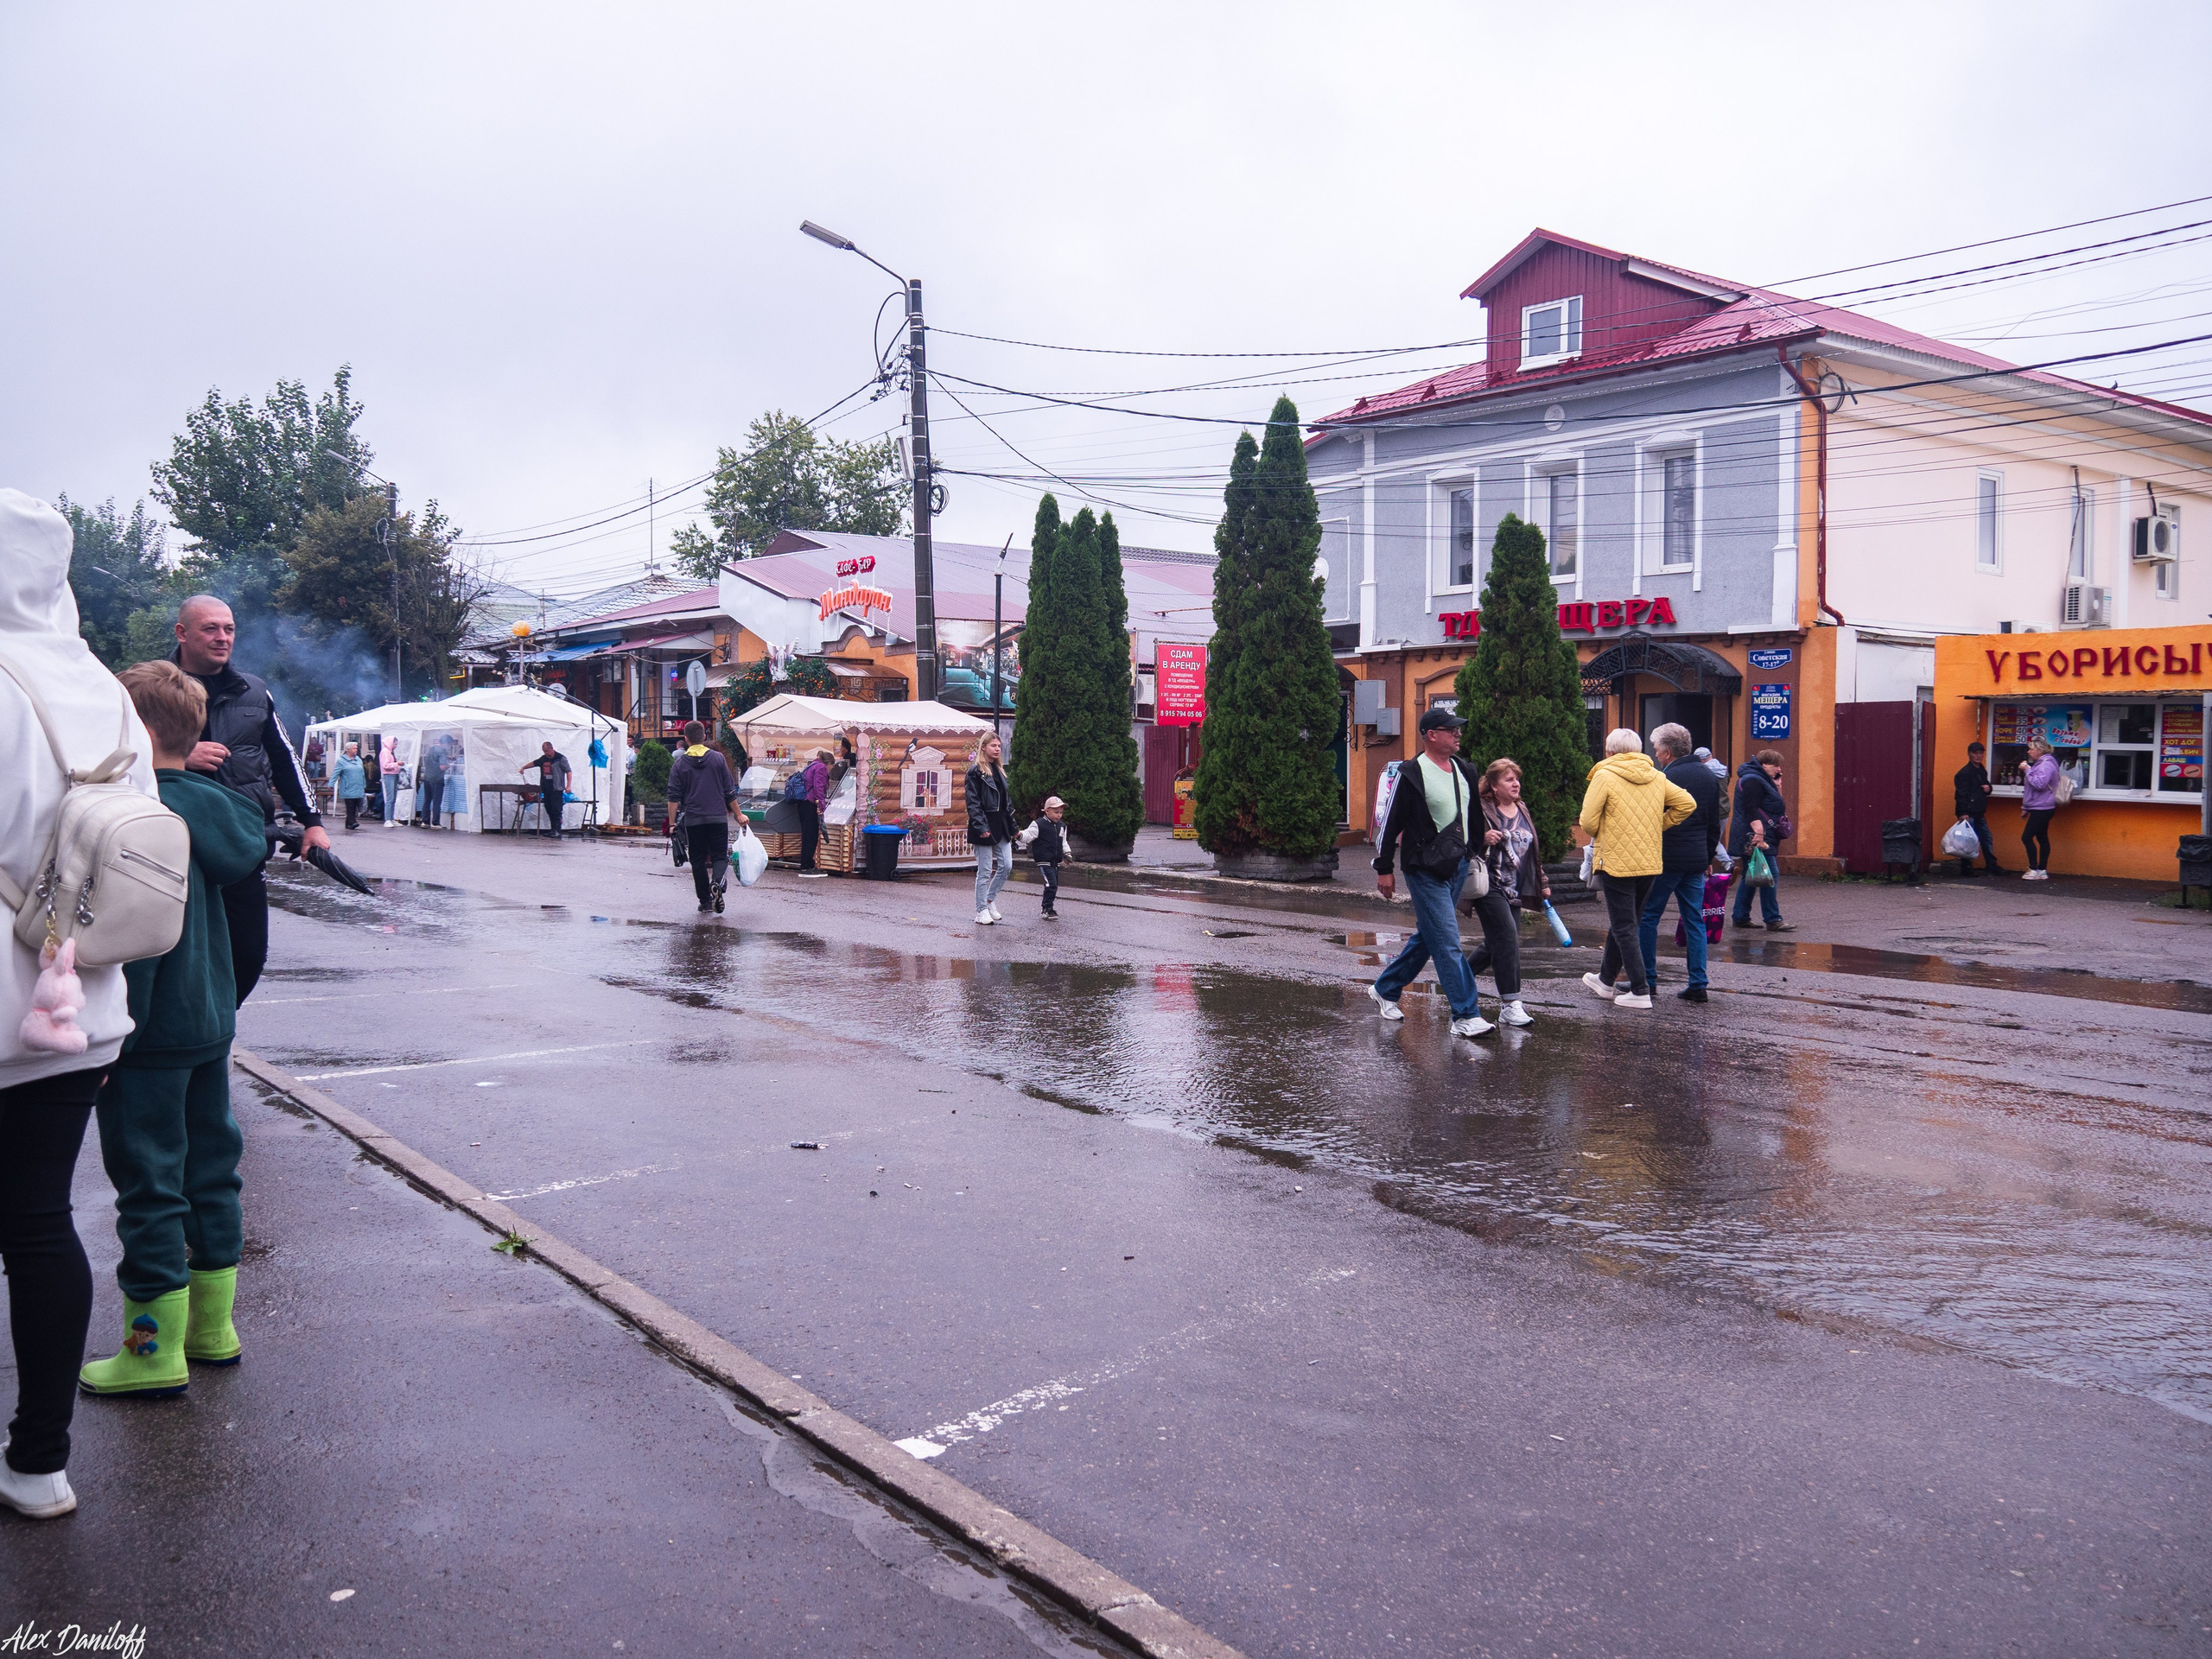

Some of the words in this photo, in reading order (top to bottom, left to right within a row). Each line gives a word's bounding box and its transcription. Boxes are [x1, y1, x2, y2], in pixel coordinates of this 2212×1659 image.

[819, 580, 893, 621] Мандарин
[1438, 610, 1480, 640] ТД
[1557, 597, 1676, 634] ЩЕРА
[1170, 650, 1193, 659] СДАМ
[1162, 660, 1168, 669] В
[1169, 661, 1201, 671] АРЕНДУ
[2018, 643, 2212, 680] БОРИСЫ
[1753, 696, 1789, 705] МЕЩЕРА
[1758, 715, 1789, 729] 8-20
[2051, 727, 2079, 736] Возьми
